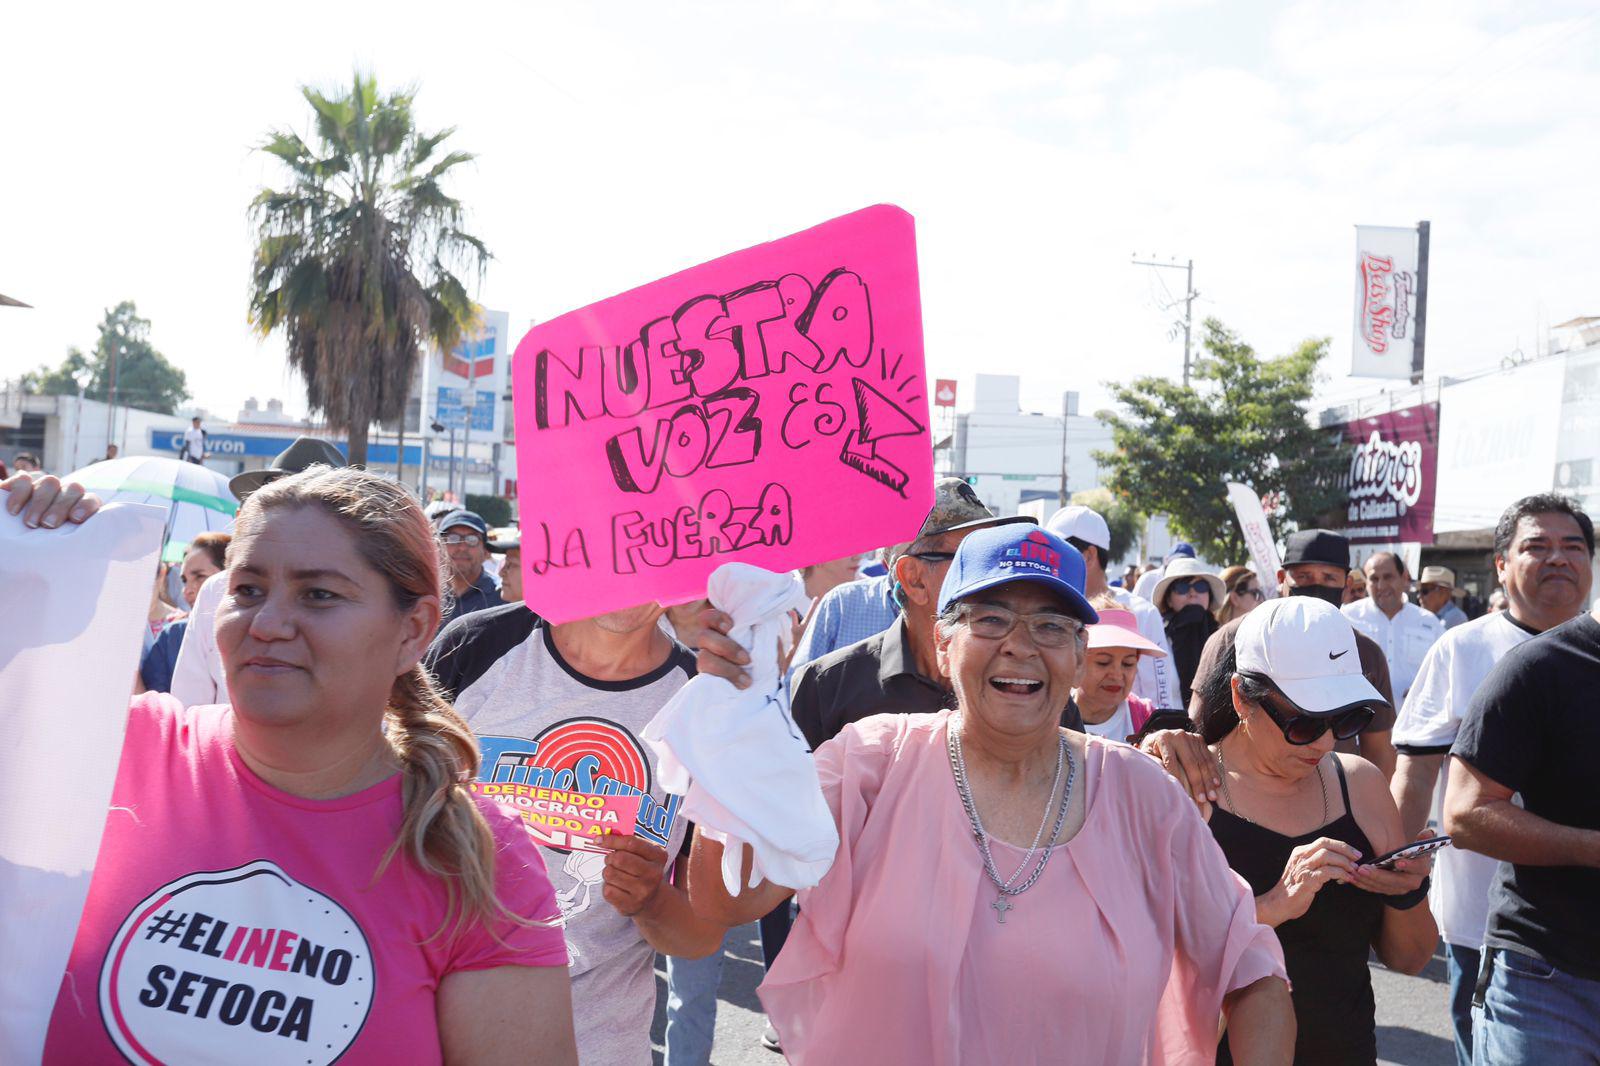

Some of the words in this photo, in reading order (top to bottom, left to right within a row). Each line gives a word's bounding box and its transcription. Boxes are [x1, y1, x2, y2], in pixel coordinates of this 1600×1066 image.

[1366, 301, 1393, 353] Shop
[535, 267, 874, 431] NUESTRA
[171, 434, 245, 454] Cvron
[605, 386, 762, 494] VOZ
[781, 382, 846, 449] ES
[533, 522, 591, 575] LA
[612, 482, 792, 574] FUERZA
[1027, 562, 1051, 574] TOCA
[1155, 655, 1166, 676] FU
[1158, 677, 1168, 701] THE
[480, 794, 618, 823] MOCRACIA
[483, 784, 605, 809] DEFIENDO
[520, 810, 583, 831] ENDO
[525, 824, 615, 852] NE
